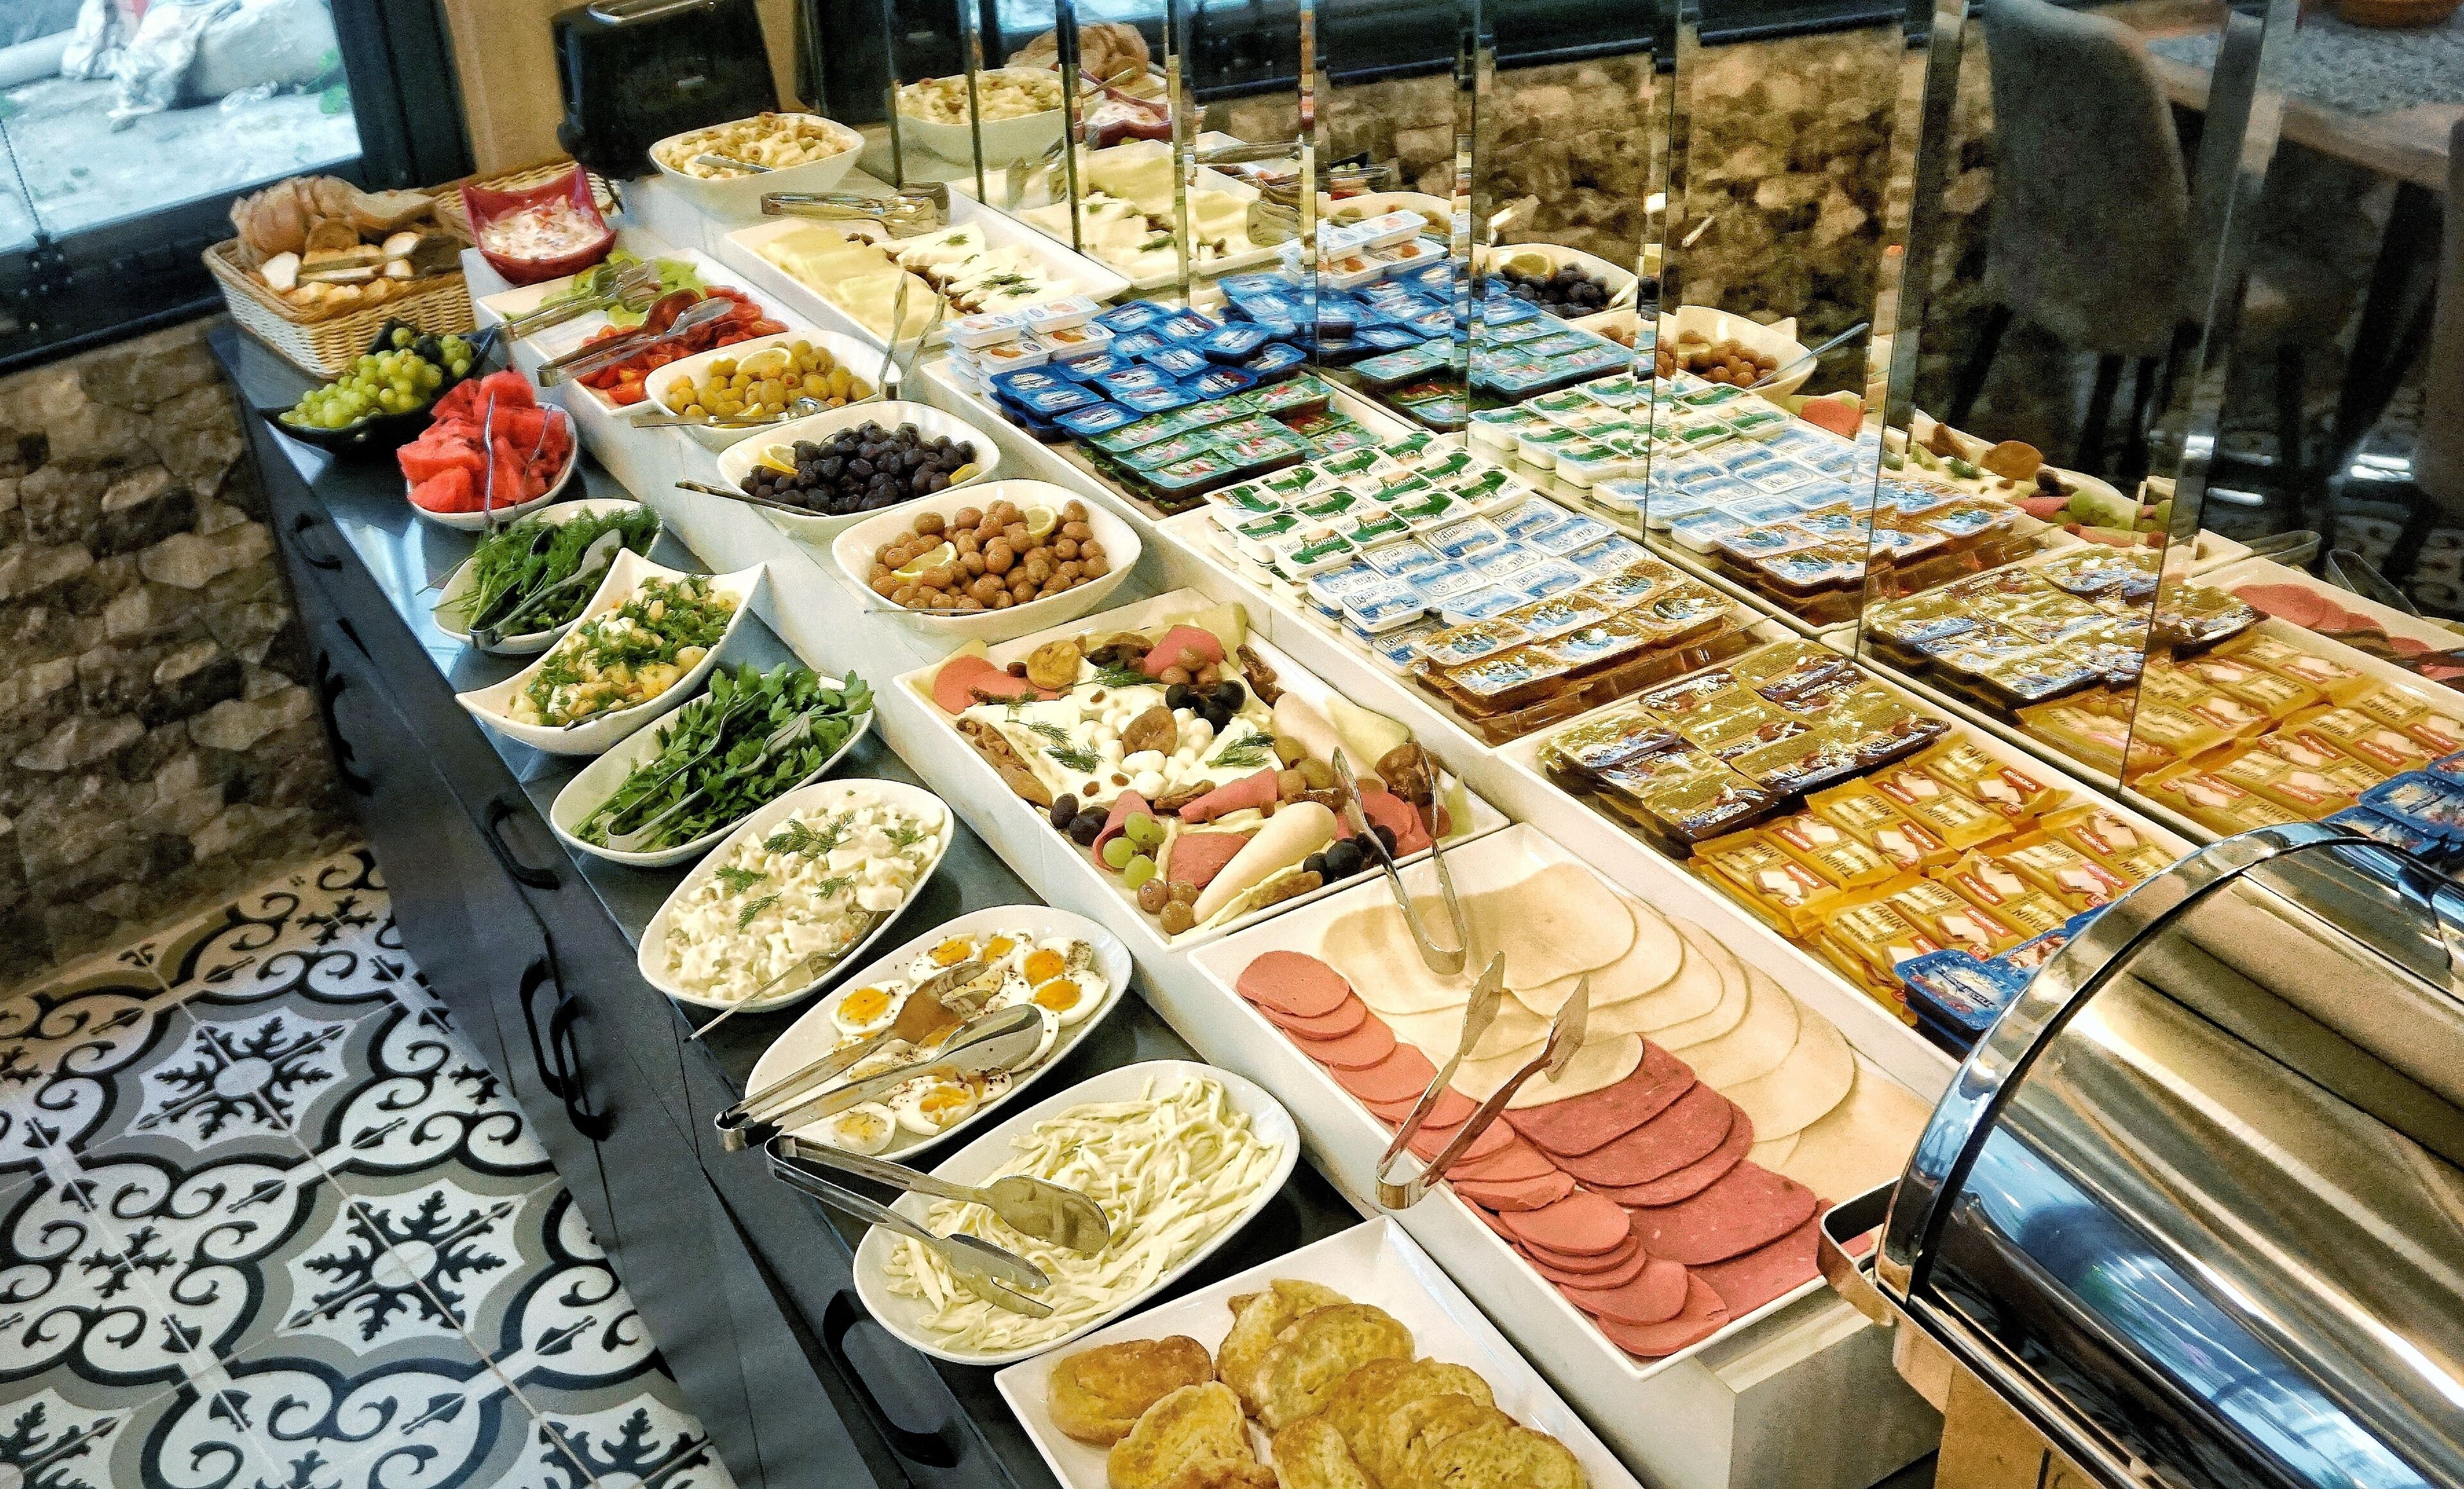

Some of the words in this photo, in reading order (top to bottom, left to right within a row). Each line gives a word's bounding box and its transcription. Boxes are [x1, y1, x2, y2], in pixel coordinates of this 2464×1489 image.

[1387, 473, 1419, 489] Labne
[1364, 515, 1396, 528] Labne
[1312, 532, 1340, 547] Labne
[1798, 680, 1841, 699] KOSKA
